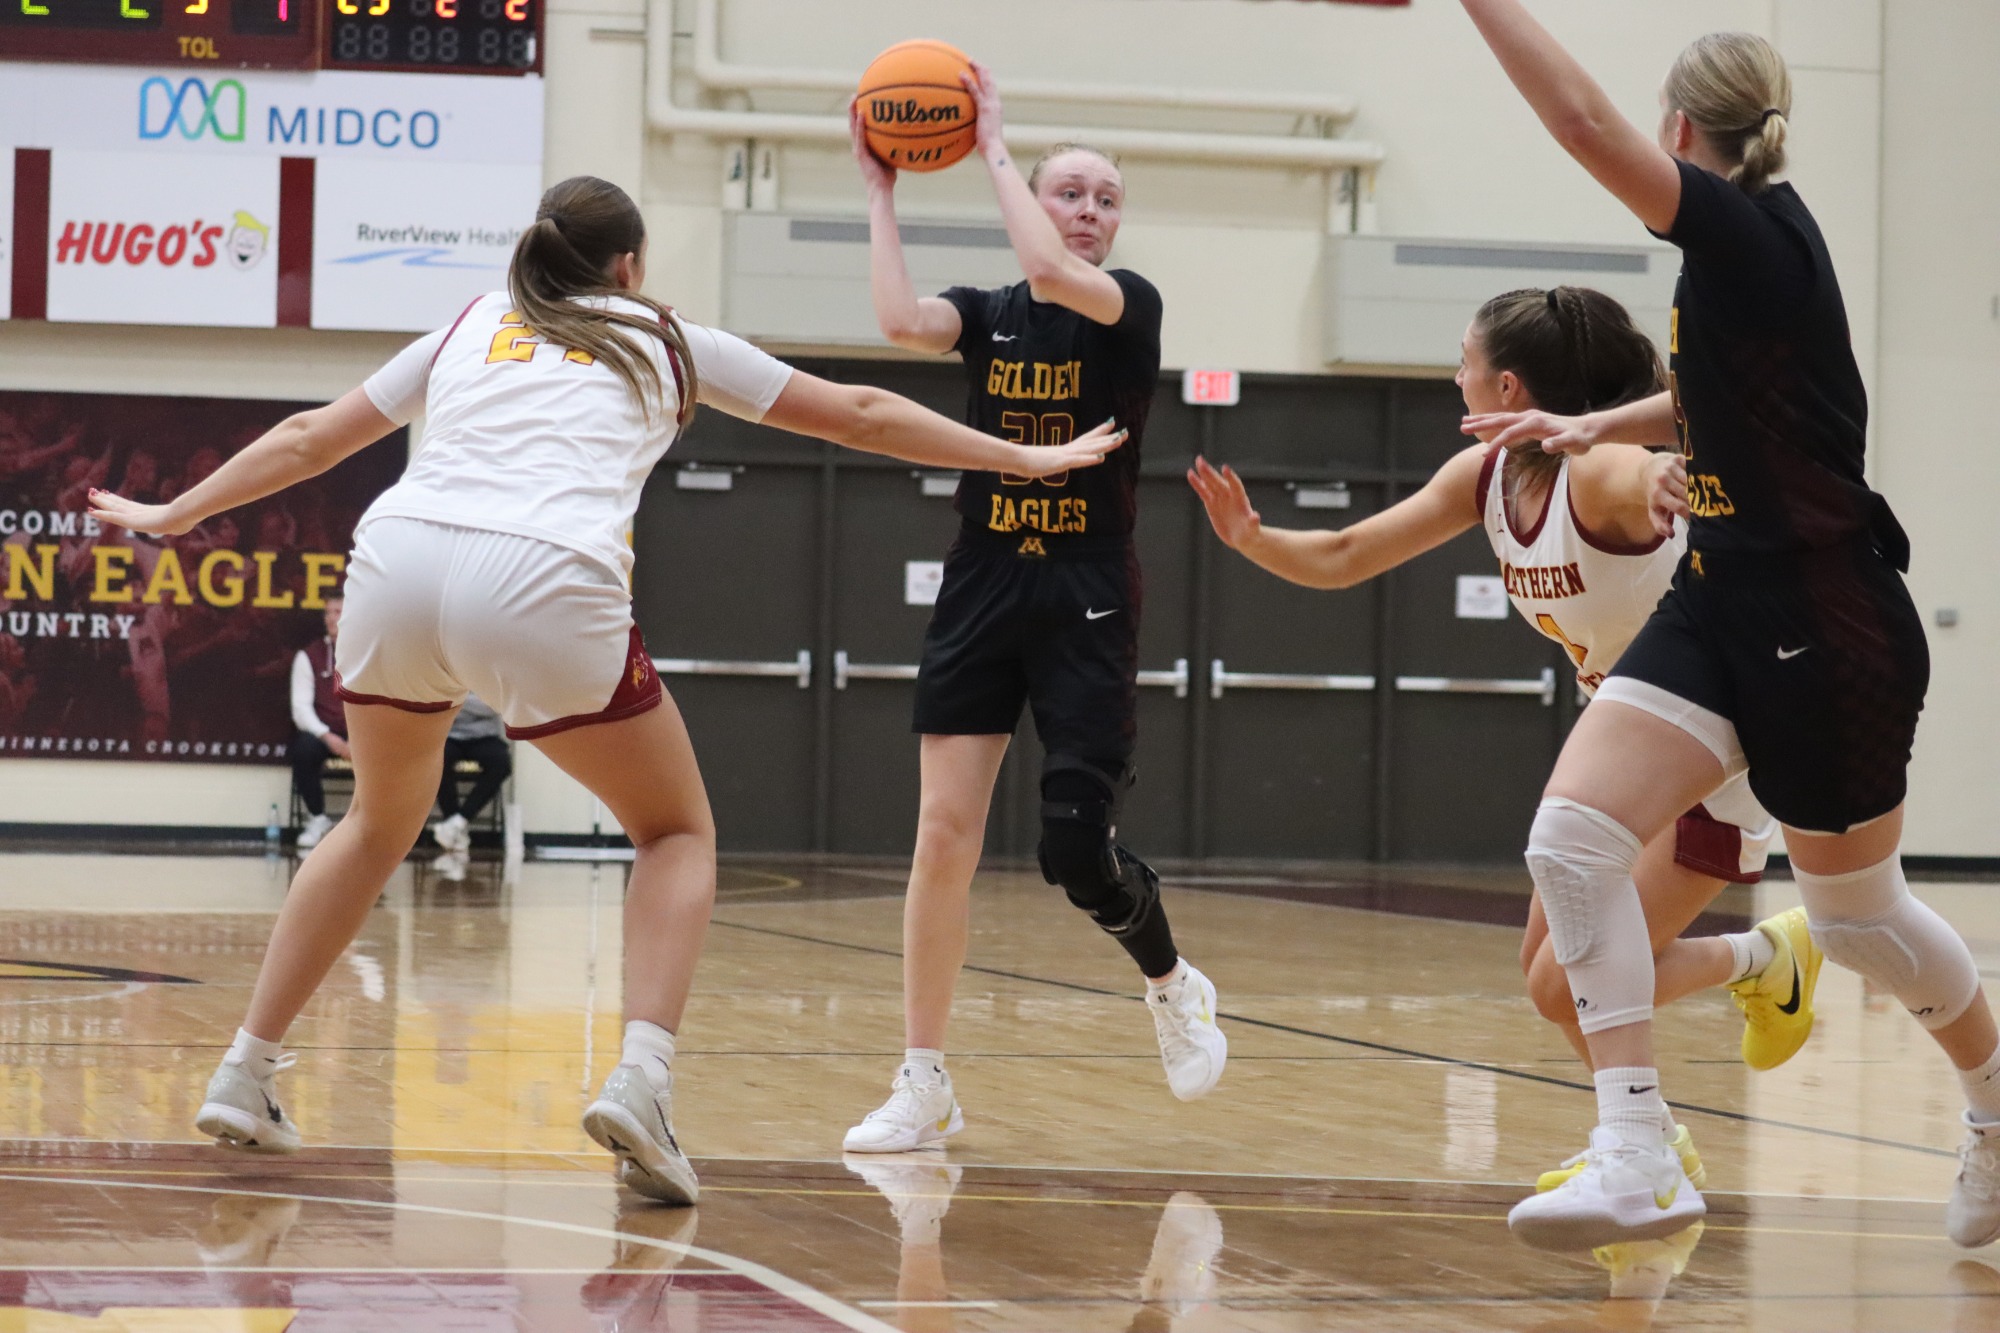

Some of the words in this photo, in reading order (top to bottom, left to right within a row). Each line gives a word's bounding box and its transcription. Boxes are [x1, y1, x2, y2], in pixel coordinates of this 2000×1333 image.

[178, 36, 220, 59] TOL
[268, 106, 440, 149] MIDCO
[872, 99, 960, 123] Wilson
[56, 219, 223, 268] HUGO'S
[987, 357, 1082, 400] GOLDEN
[1193, 370, 1233, 402] EXIT
[1001, 410, 1074, 487] 30
[988, 494, 1087, 534] EAGLES
[146, 739, 287, 758] CROOKSTON
